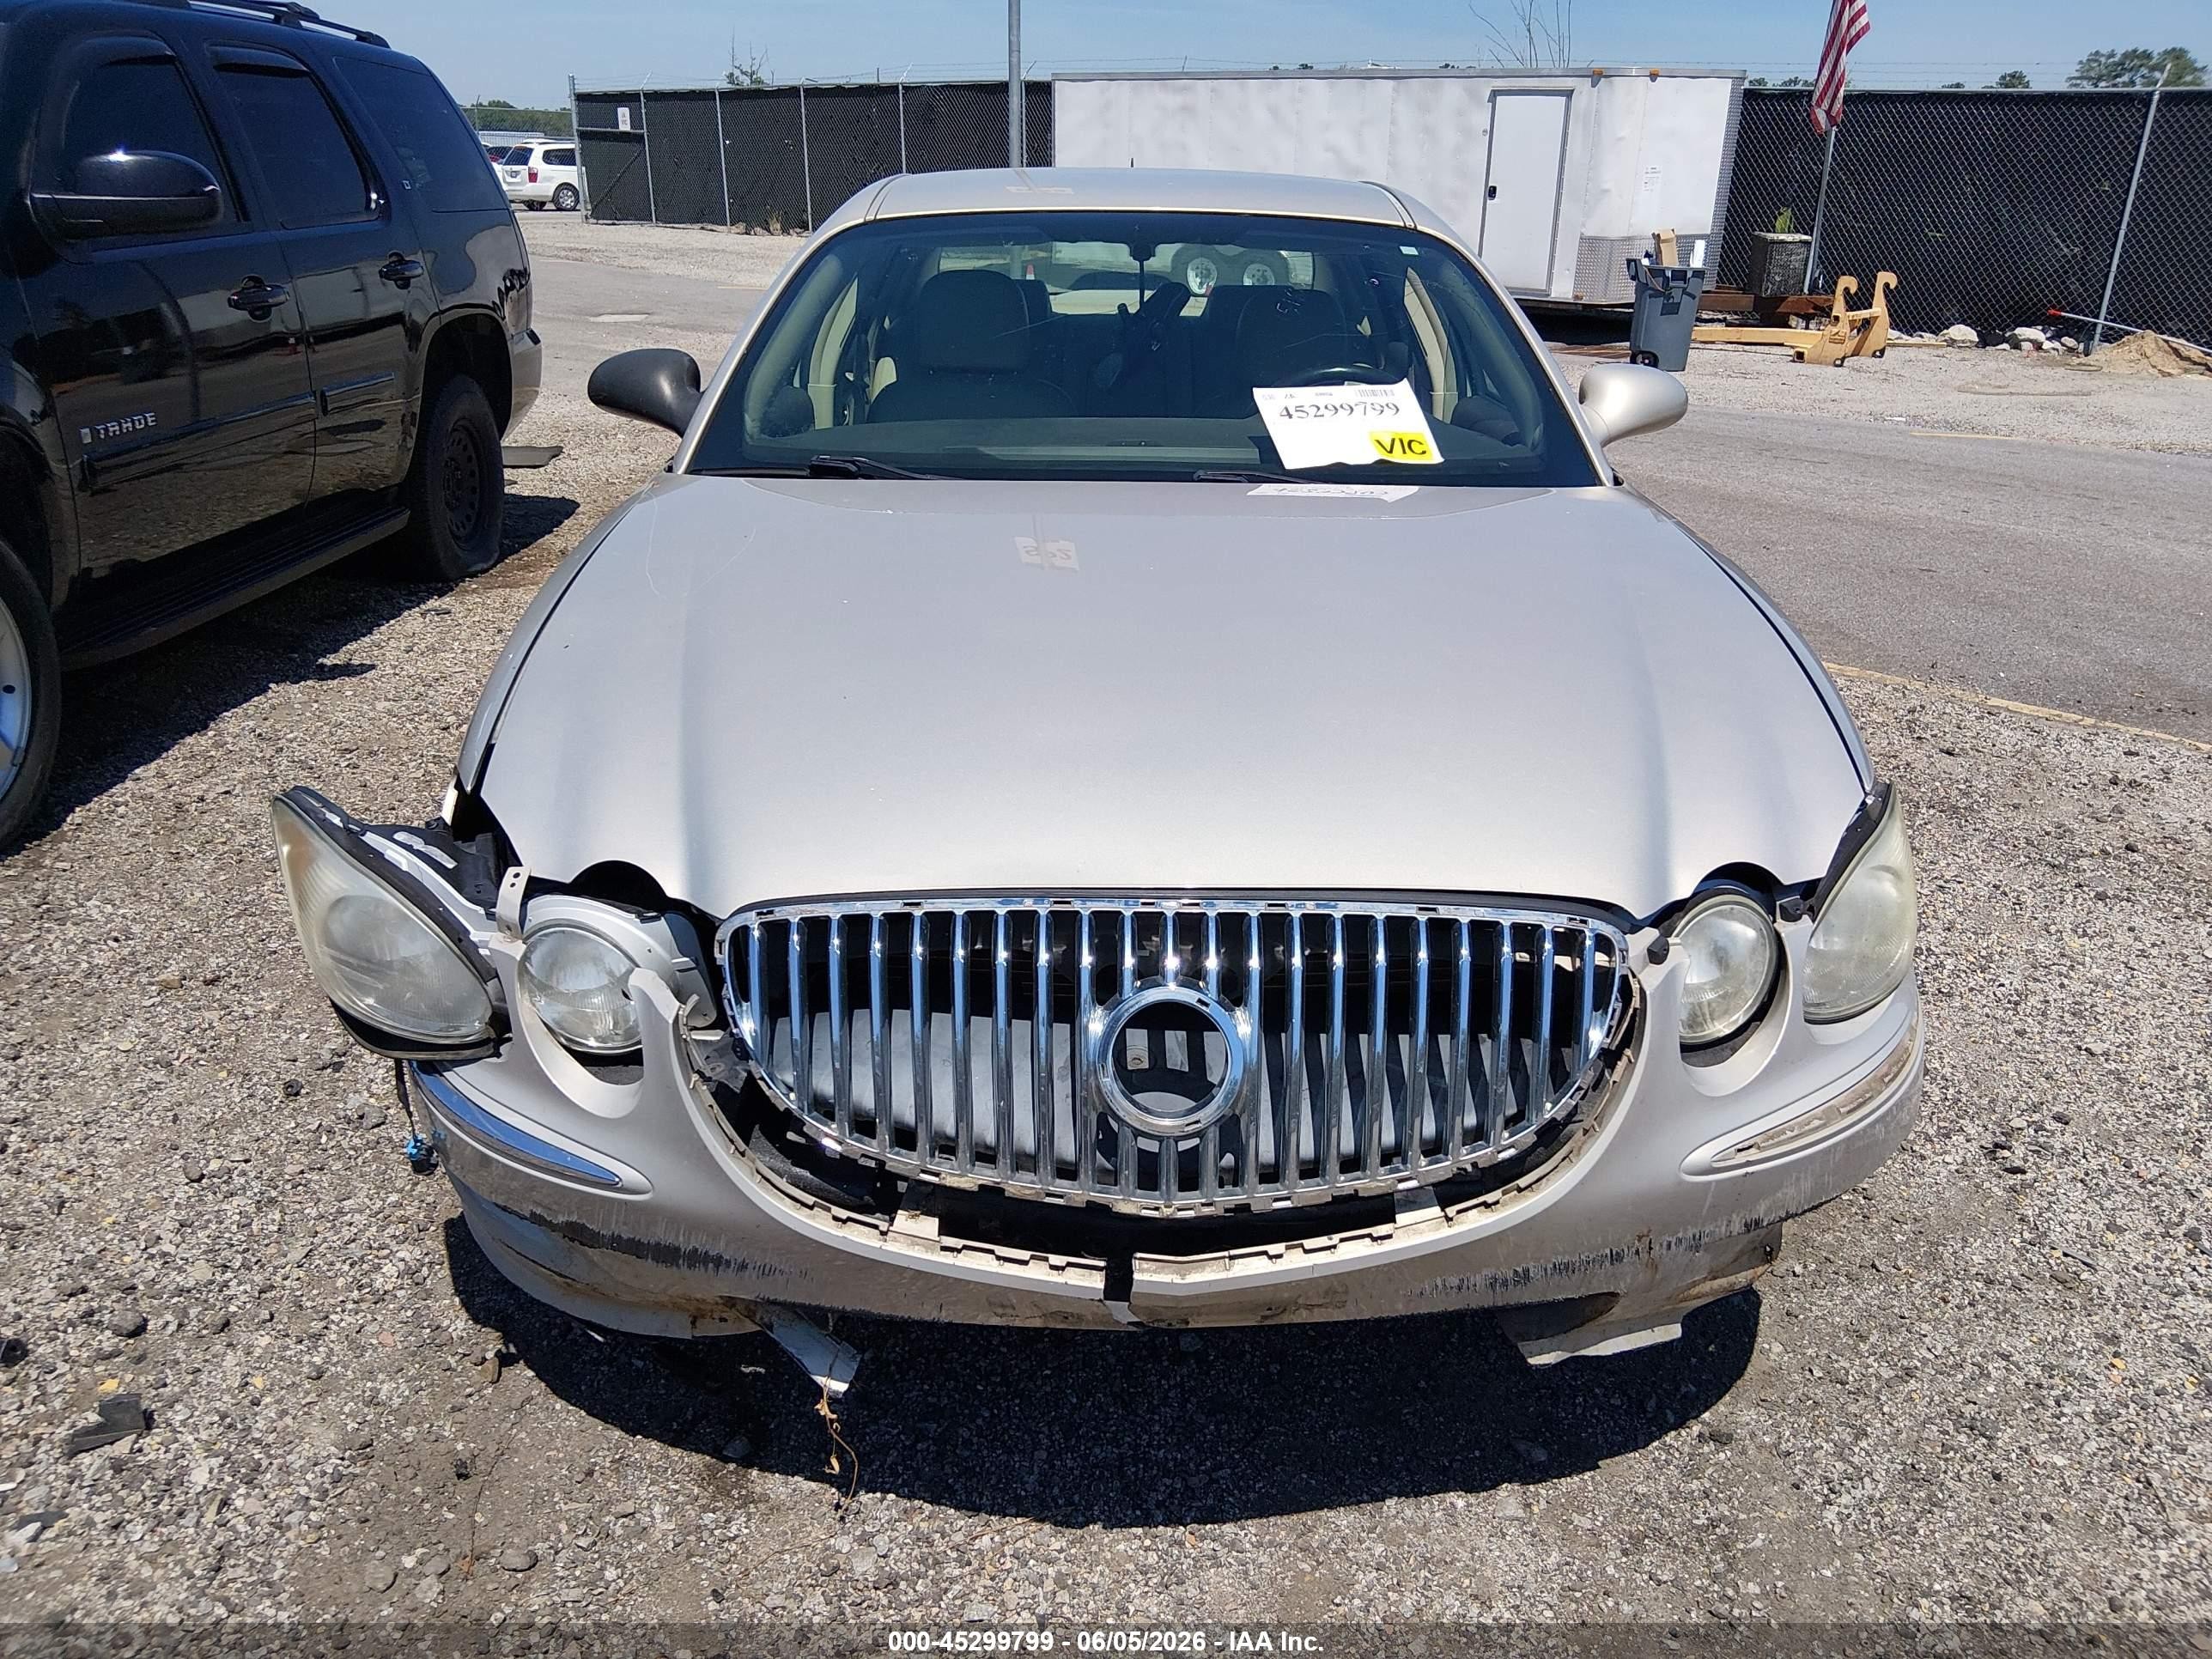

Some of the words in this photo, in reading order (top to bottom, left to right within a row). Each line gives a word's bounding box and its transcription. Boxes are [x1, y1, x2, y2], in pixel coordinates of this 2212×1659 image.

[1279, 401, 1400, 419] 45299799
[94, 412, 157, 439] TAHOE
[1374, 437, 1427, 455] VIC
